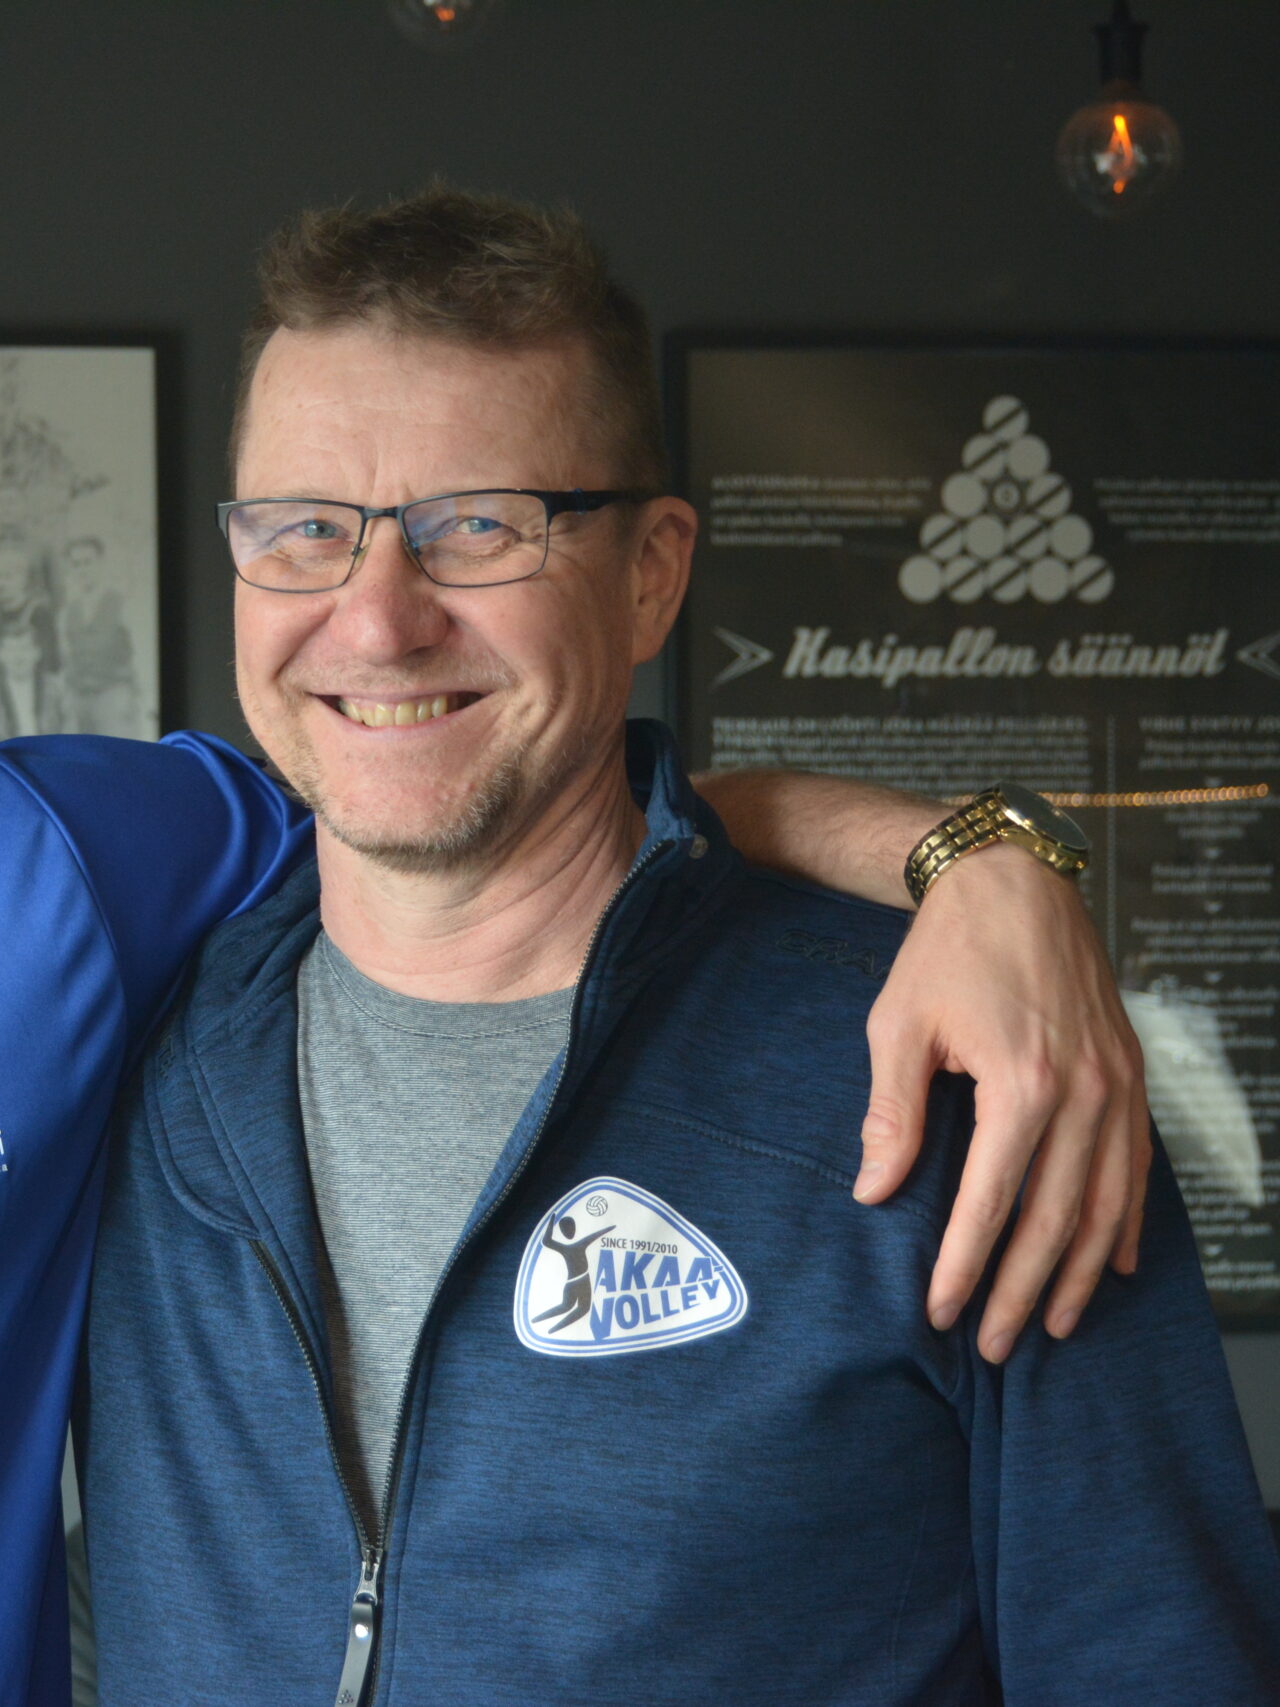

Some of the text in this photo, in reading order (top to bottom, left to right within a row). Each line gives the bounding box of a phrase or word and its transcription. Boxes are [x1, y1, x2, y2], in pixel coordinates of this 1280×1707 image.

[782, 626, 1040, 688] Kasipallon
[600, 1237, 678, 1255] SINCE 1991/2010
[590, 1279, 721, 1341] VOLLEY
